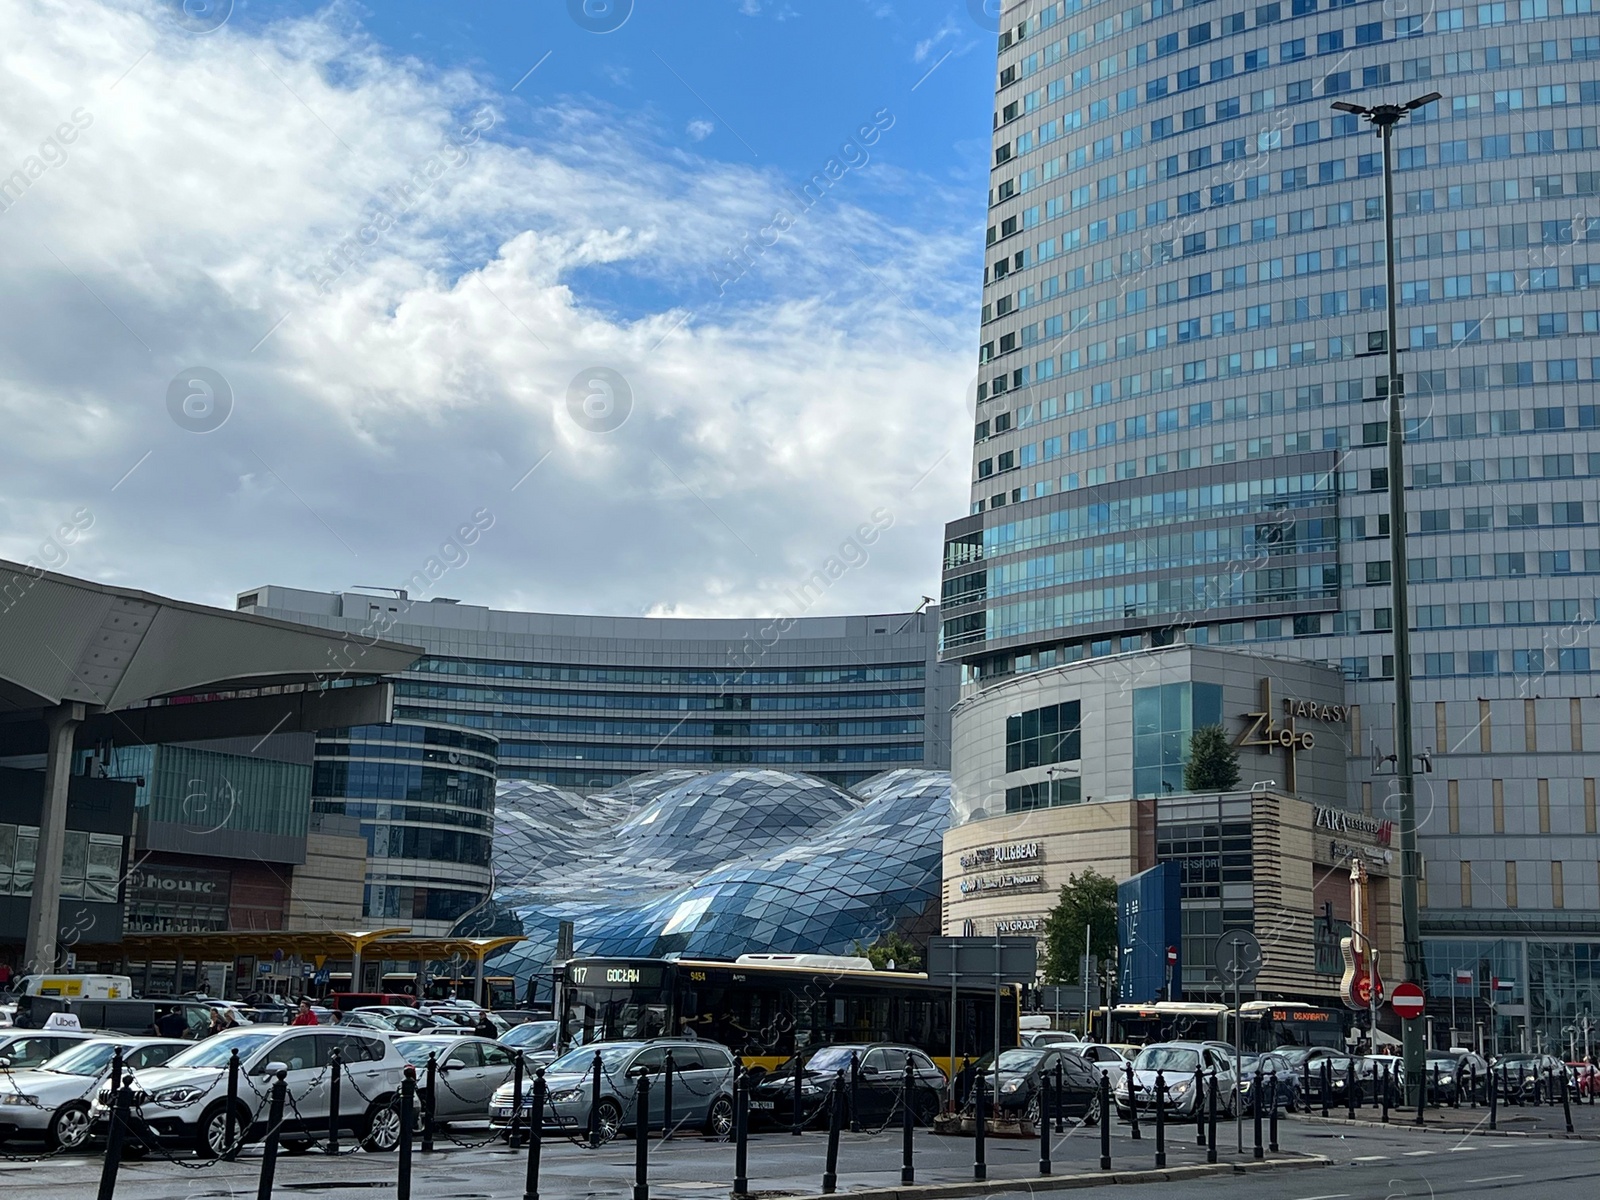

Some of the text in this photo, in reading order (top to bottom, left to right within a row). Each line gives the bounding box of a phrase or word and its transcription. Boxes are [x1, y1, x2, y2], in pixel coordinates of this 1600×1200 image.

[1285, 697, 1351, 722] TARASY
[1315, 806, 1347, 832] ZARA
[994, 843, 1038, 862] PULL&BEAR
[1009, 919, 1039, 931] GRAAF
[573, 967, 640, 984] 117 GOCŁAW
[690, 971, 706, 981] 9454
[55, 1016, 77, 1027] Uber
